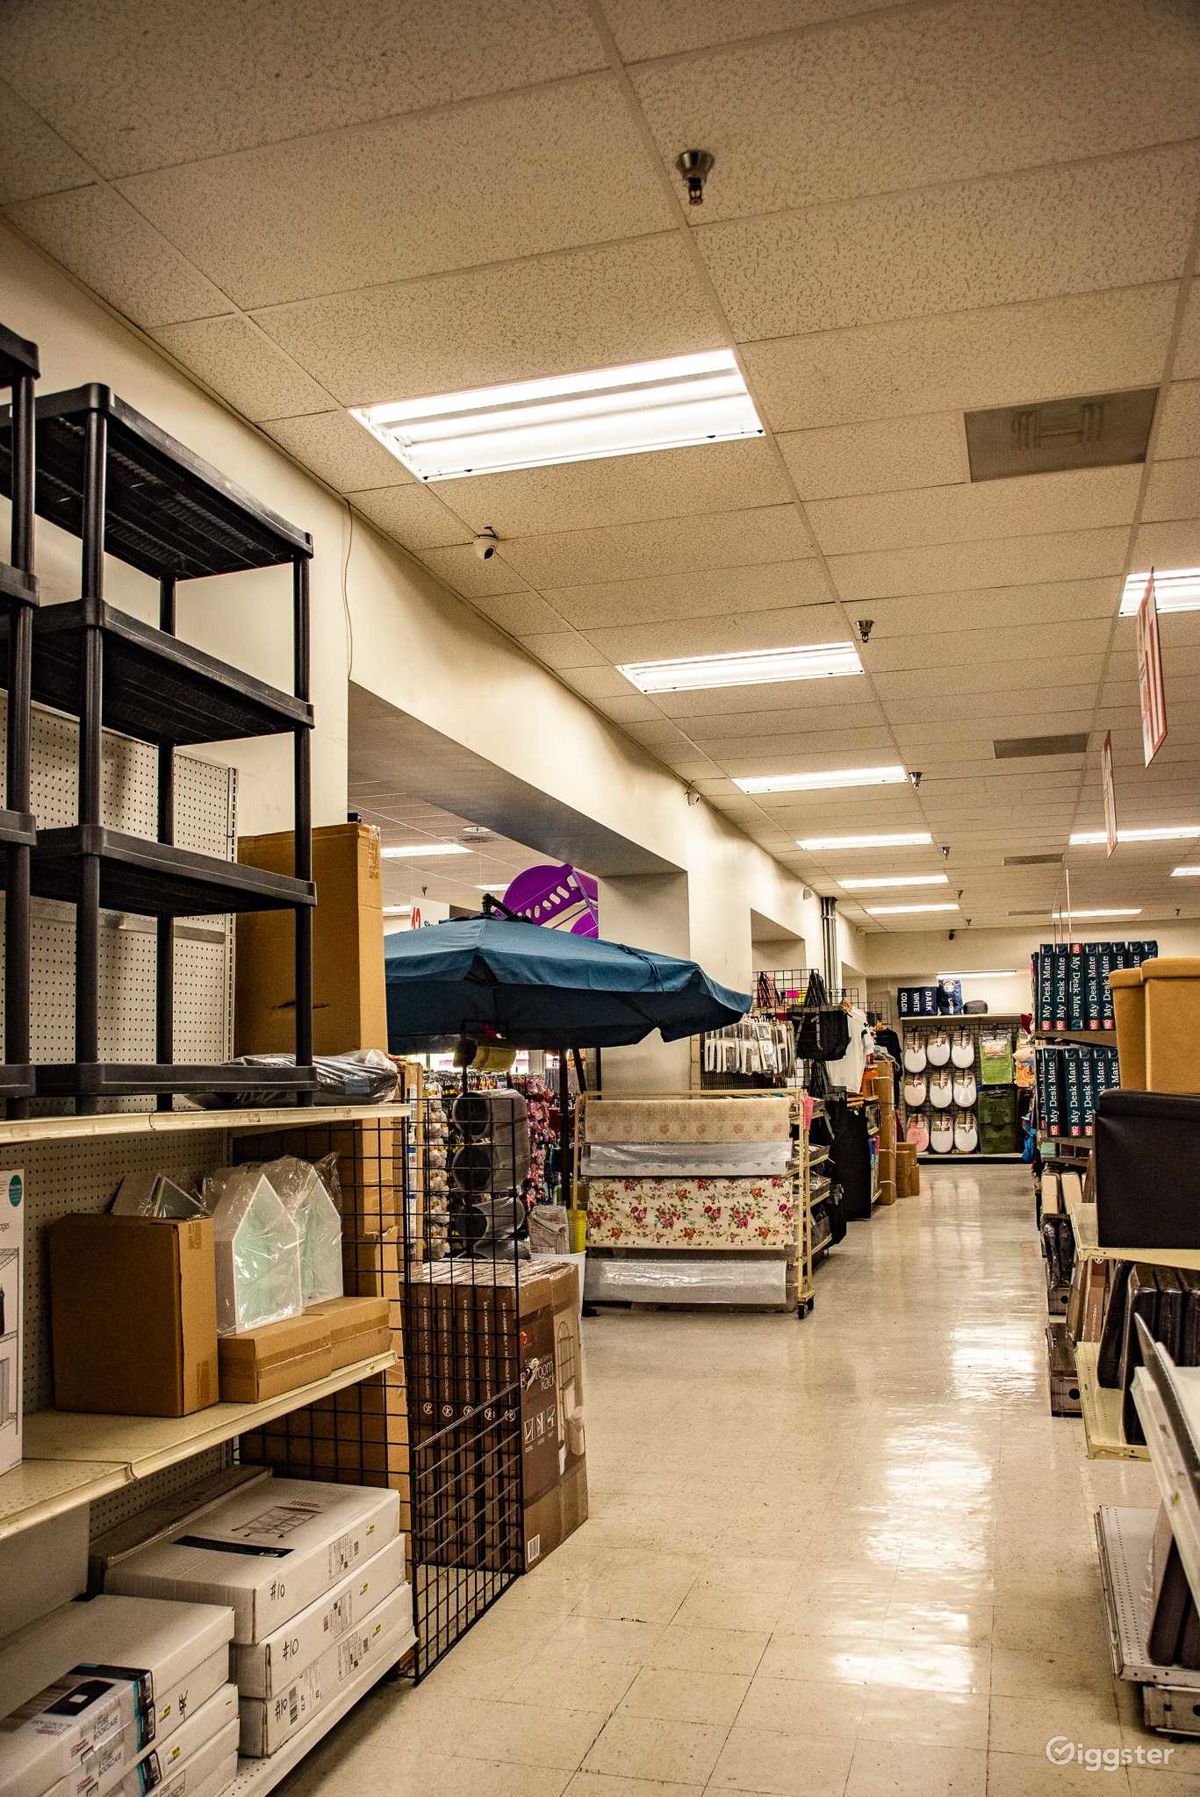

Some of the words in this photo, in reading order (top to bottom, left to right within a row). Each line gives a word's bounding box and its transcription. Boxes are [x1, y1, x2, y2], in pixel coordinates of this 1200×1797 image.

[1042, 957, 1051, 978] Mate
[1070, 957, 1080, 970] My
[1042, 981, 1050, 1002] Desk
[1089, 980, 1097, 1001] Desk
[1102, 980, 1111, 1000] Desk
[1042, 1005, 1052, 1018] My
[1057, 1005, 1066, 1018] My
[1090, 1004, 1099, 1017] My
[1104, 1003, 1113, 1016] My
[1097, 1062, 1105, 1083] Mate
[1049, 1085, 1057, 1107] Desk
[1069, 1086, 1078, 1107] Desk
[1083, 1085, 1092, 1107] Desk
[1050, 1110, 1059, 1122] My
[1072, 1110, 1080, 1123] My
[1085, 1109, 1094, 1122] My
[270, 1581, 285, 1600] #10
[282, 1638, 299, 1660] #10
[274, 1698, 287, 1722] #10
